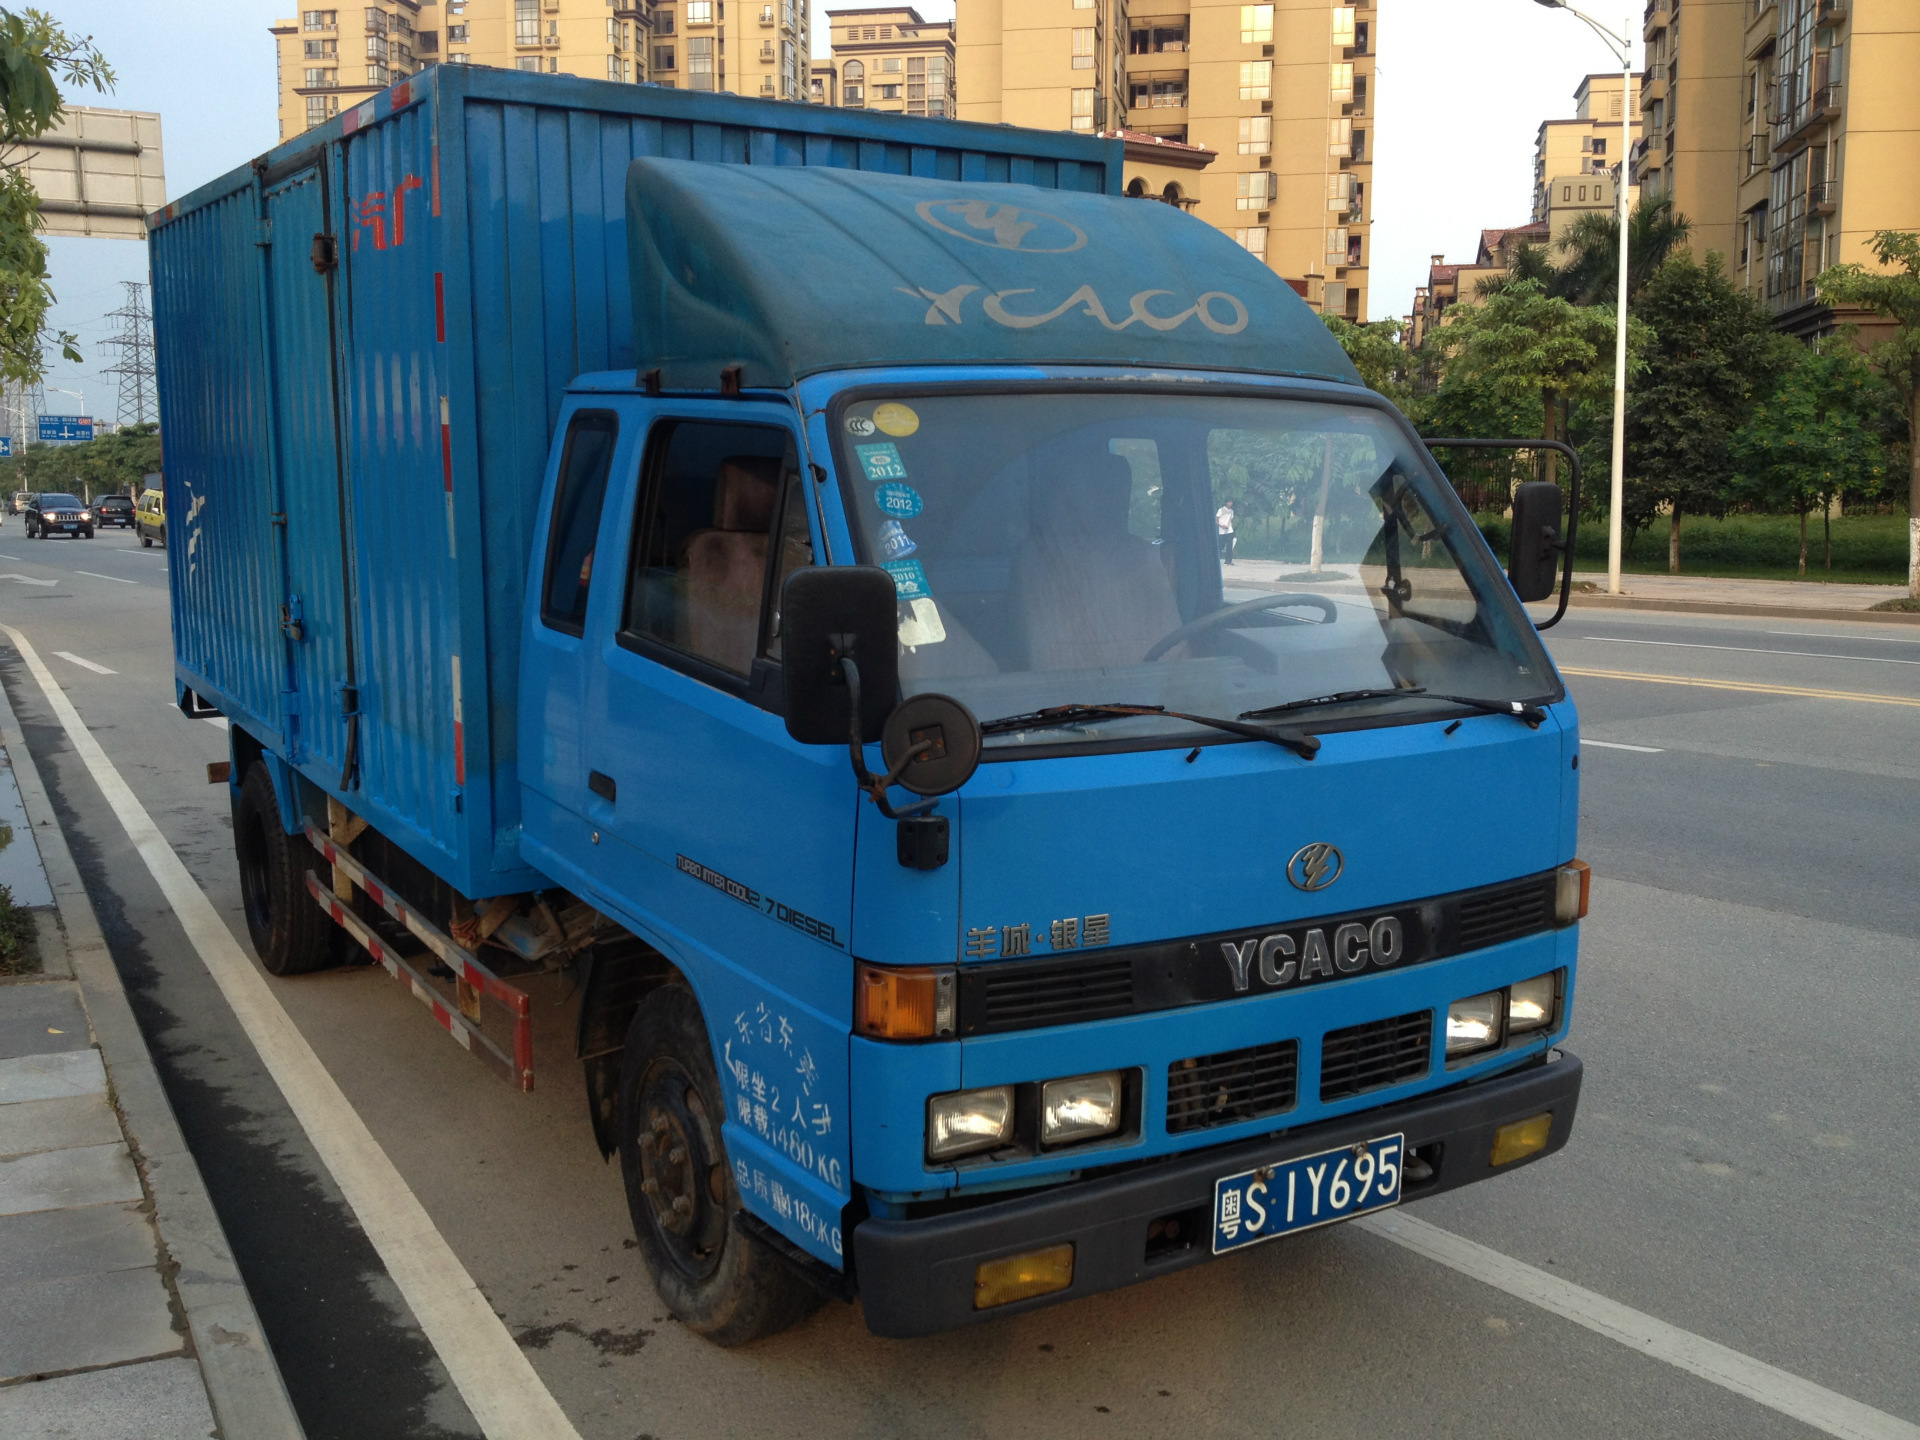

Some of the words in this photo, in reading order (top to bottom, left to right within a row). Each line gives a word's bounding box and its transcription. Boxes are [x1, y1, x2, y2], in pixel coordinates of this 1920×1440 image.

[868, 464, 903, 478] 2012
[885, 496, 913, 511] 2012
[884, 534, 911, 555] 2011
[892, 571, 916, 582] 2010
[677, 854, 701, 878] TURBO
[703, 867, 725, 889] INTER
[727, 879, 750, 903] COOL
[1220, 916, 1404, 992] YCACO
